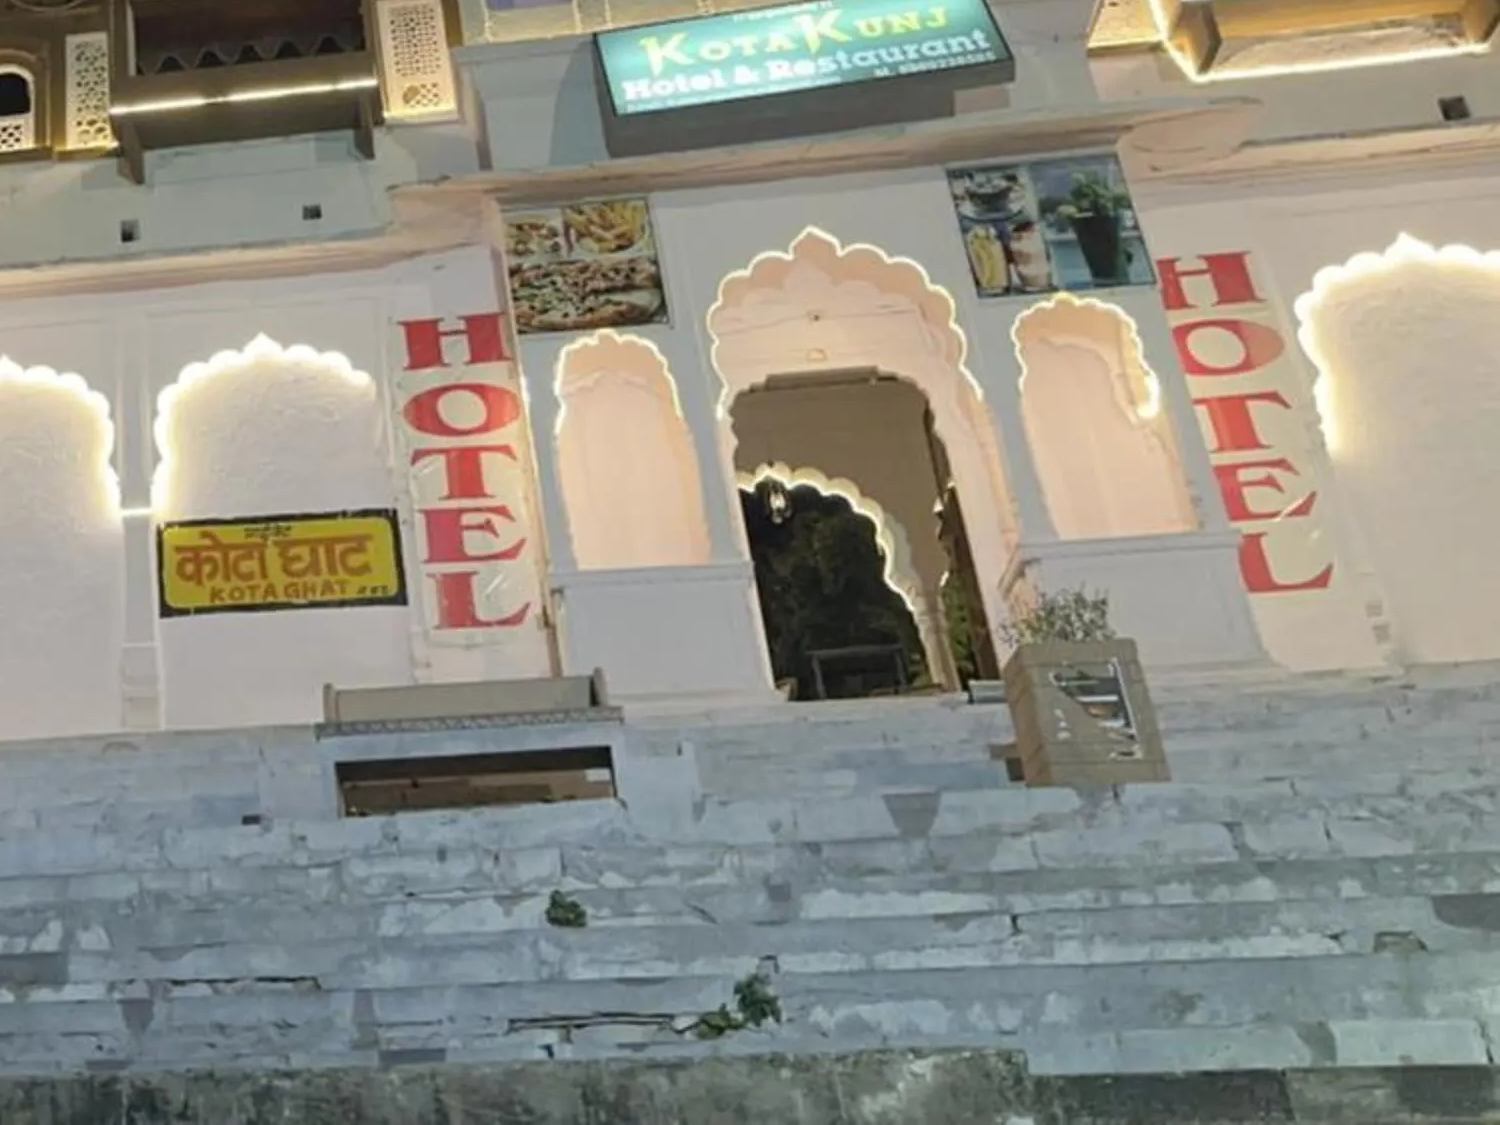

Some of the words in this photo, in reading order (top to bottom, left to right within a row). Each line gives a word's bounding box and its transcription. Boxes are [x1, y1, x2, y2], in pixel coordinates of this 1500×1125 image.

[622, 65, 727, 103] Hotel
[733, 62, 761, 86] &
[764, 28, 993, 80] Restaurant
[638, 29, 796, 79] KOTA
[792, 6, 952, 57] KUNJ
[1156, 250, 1334, 594] HOTEL
[398, 311, 532, 630] HOTEL
[174, 530, 268, 586] कोटा
[273, 533, 375, 579] घाट
